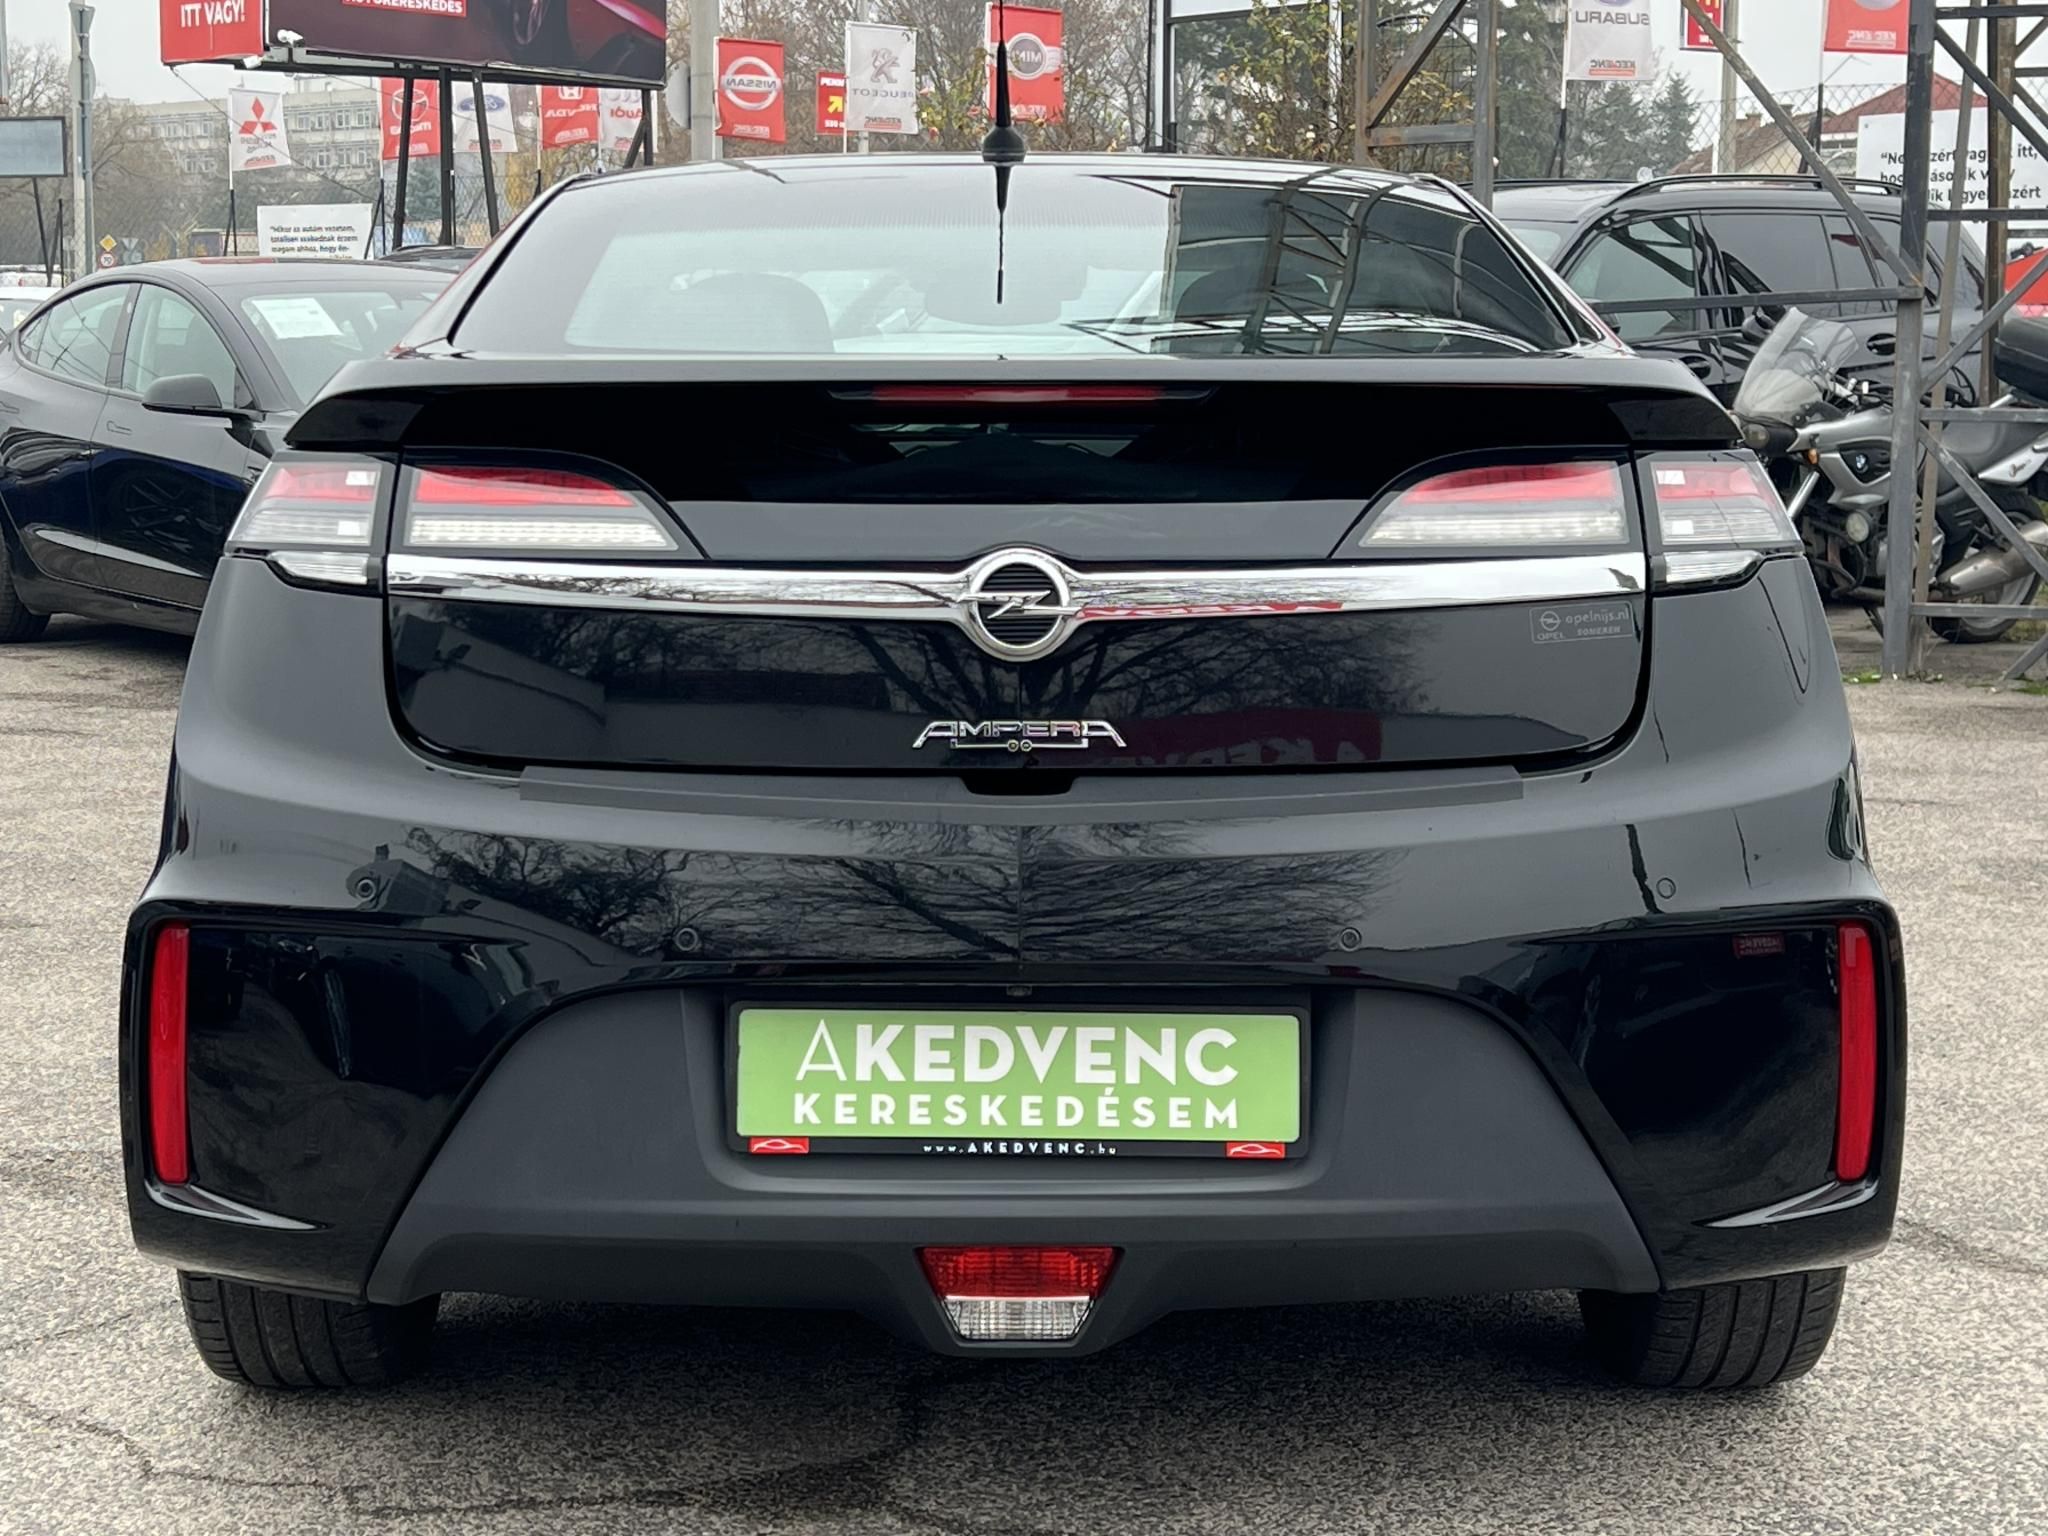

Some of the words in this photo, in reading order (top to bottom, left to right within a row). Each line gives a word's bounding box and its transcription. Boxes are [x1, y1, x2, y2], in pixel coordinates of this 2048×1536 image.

[180, 2, 202, 28] ITT
[204, 0, 245, 25] VAGY!
[2017, 143, 2038, 160] itt,
[2011, 184, 2041, 199] zért
[319, 244, 337, 254] hogy
[911, 719, 1128, 749] AMPERA
[795, 1018, 1239, 1087] AKEDVENC
[793, 1087, 1238, 1129] KERESKEDÉSEM
